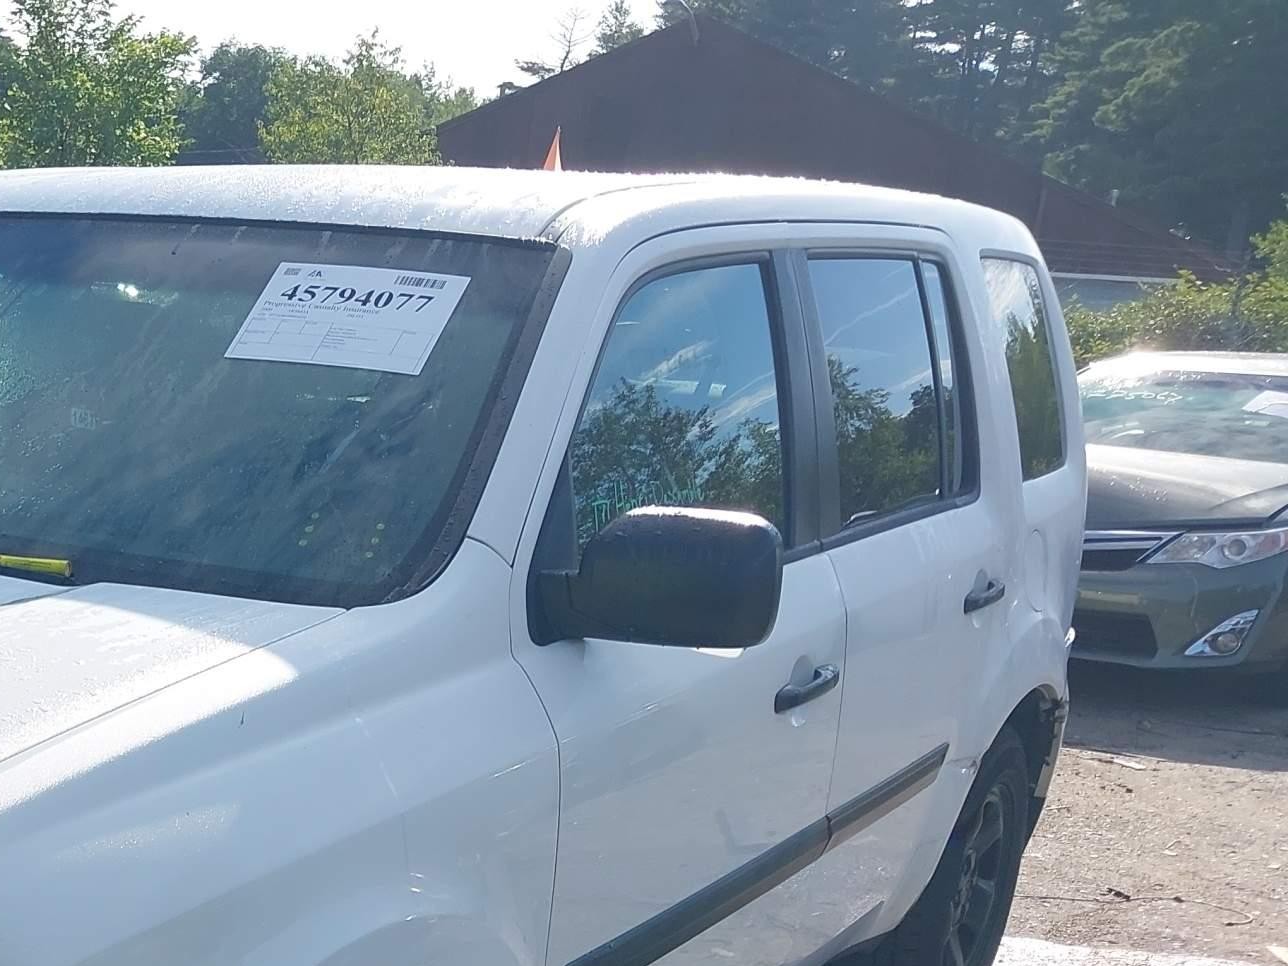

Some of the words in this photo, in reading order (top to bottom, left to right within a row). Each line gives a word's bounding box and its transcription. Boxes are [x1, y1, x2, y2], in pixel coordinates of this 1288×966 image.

[263, 300, 307, 309] Progressive
[308, 303, 341, 313] Casualty
[342, 305, 380, 315] Insurance
[280, 283, 435, 313] 45794077
